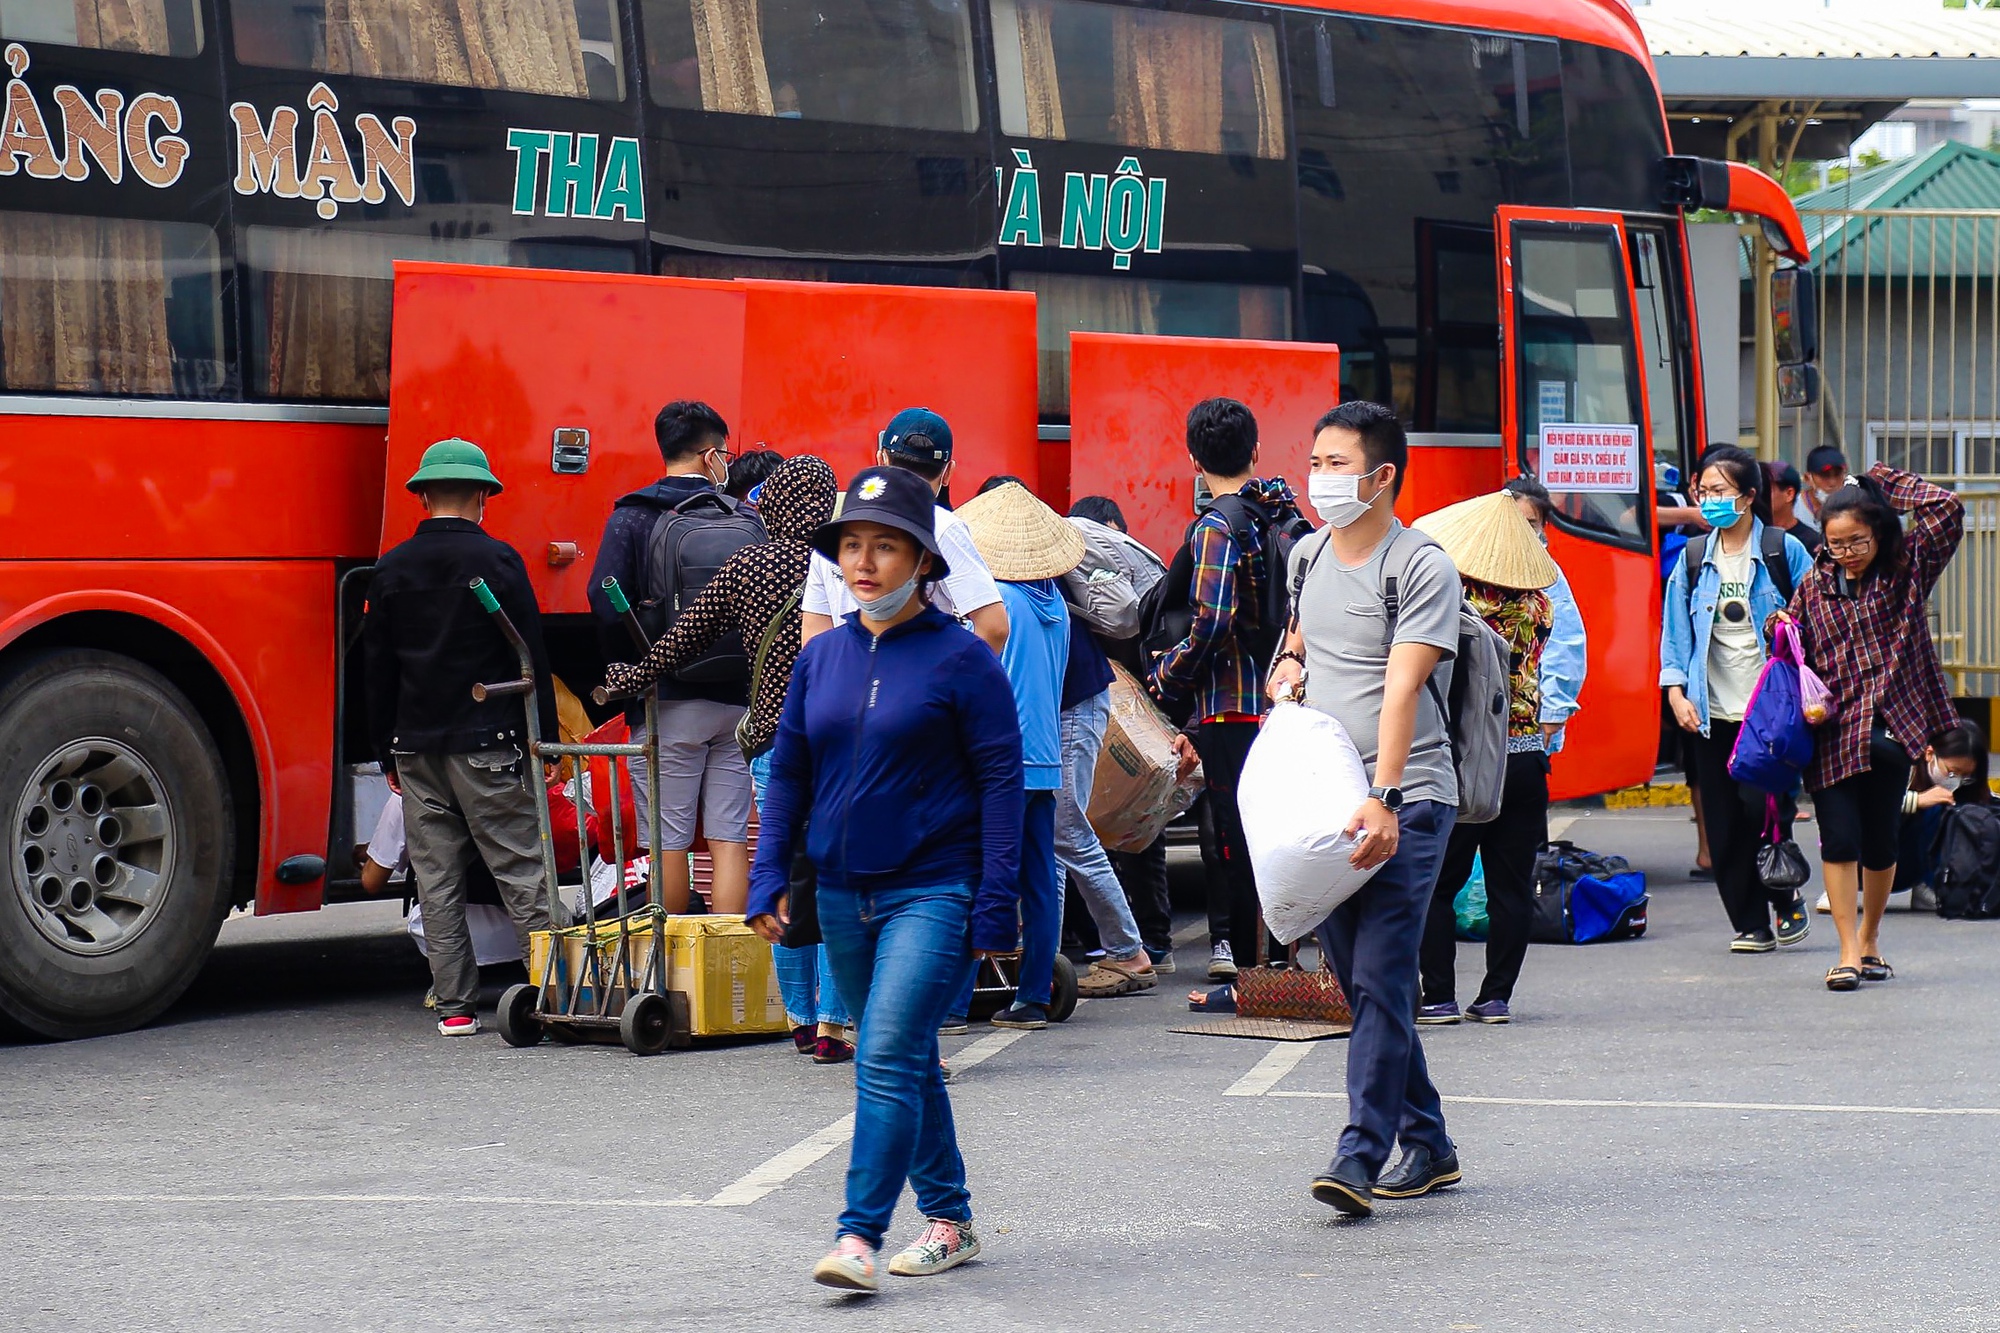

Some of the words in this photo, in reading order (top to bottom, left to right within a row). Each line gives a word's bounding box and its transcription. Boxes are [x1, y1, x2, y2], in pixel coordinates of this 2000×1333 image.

[0, 43, 190, 188] ẢNG
[229, 82, 417, 219] MẬN
[506, 128, 645, 222] THA
[995, 148, 1043, 247] À
[1060, 156, 1167, 270] NỘI
